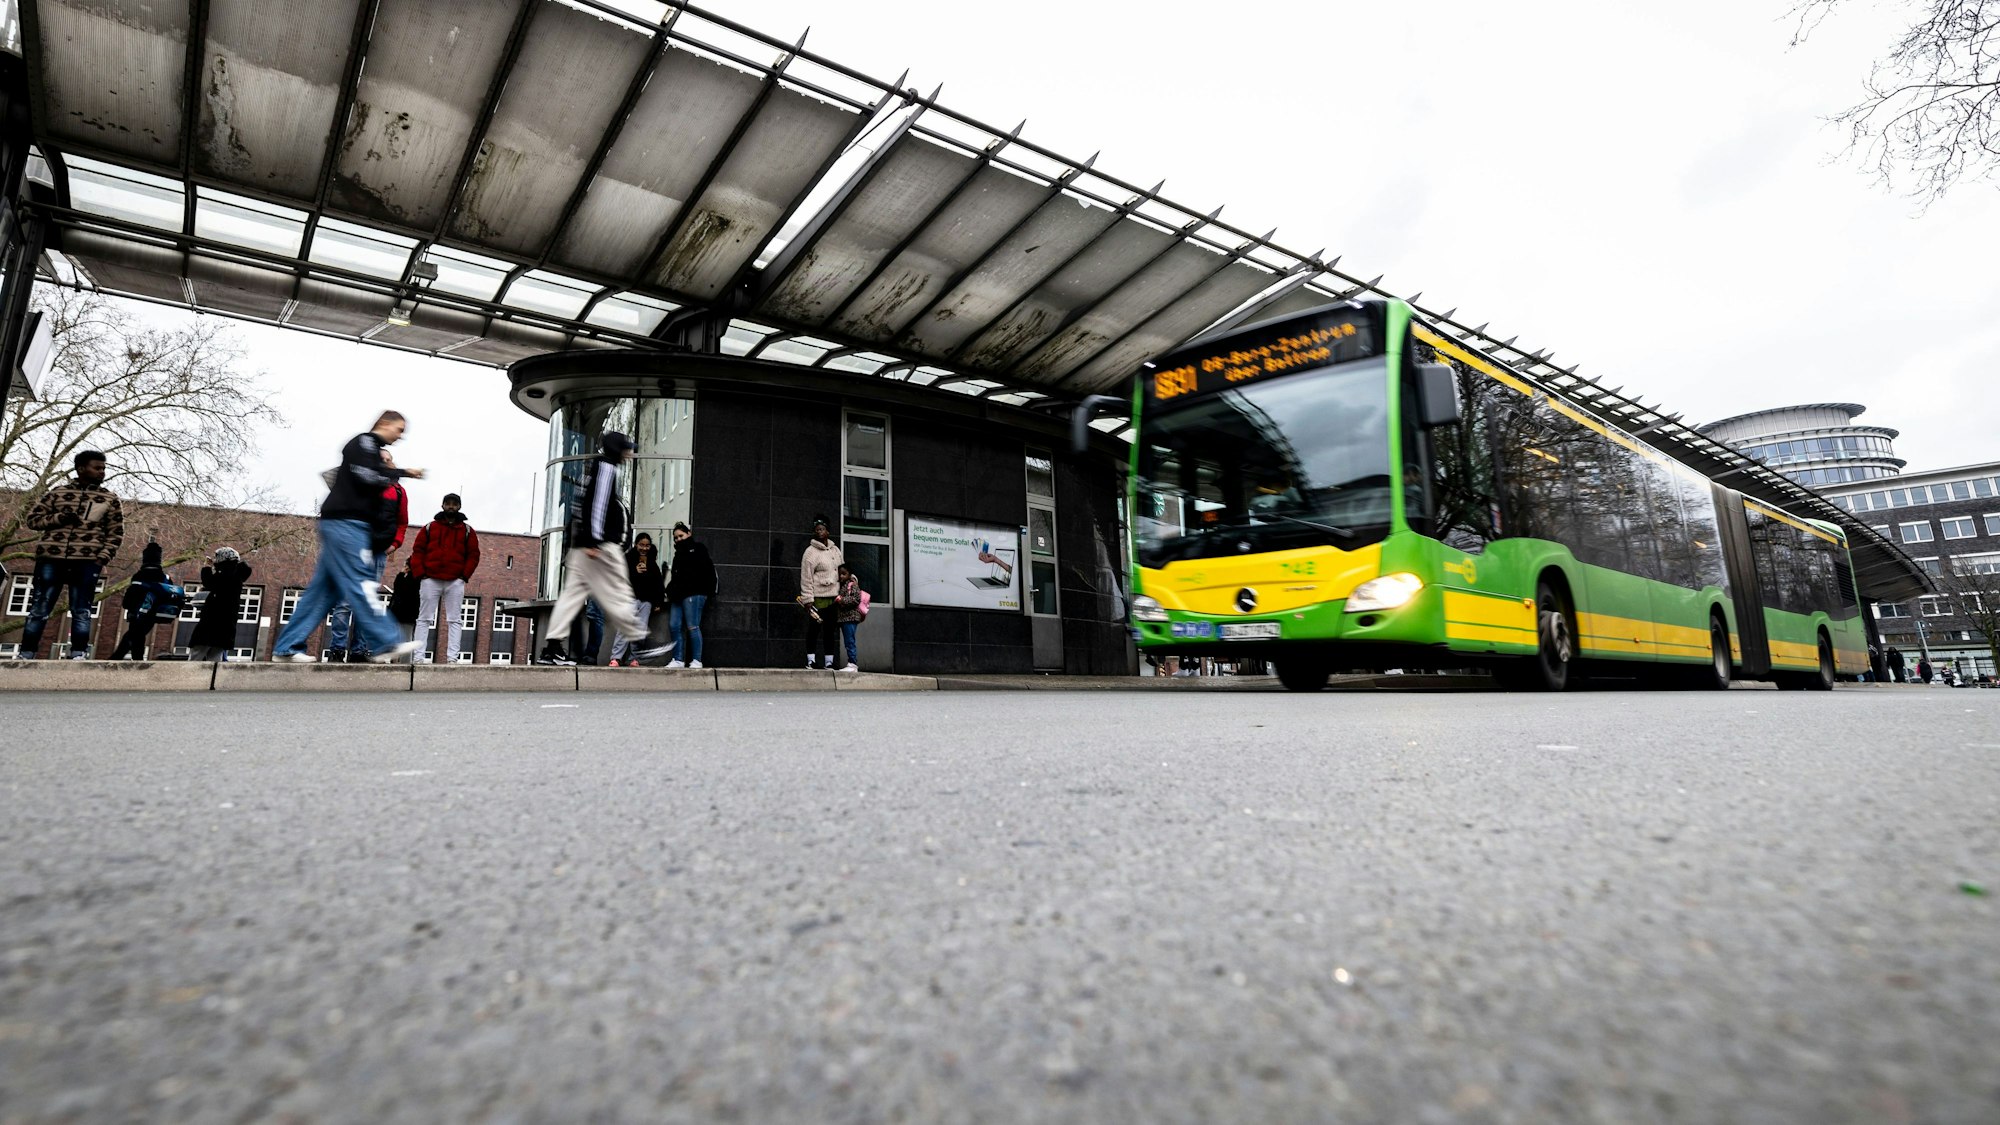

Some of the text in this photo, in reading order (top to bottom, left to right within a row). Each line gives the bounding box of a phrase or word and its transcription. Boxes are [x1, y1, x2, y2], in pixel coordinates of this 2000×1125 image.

[913, 524, 928, 532] Jetzt
[913, 532, 939, 542] bequem
[954, 538, 970, 546] Sofa!
